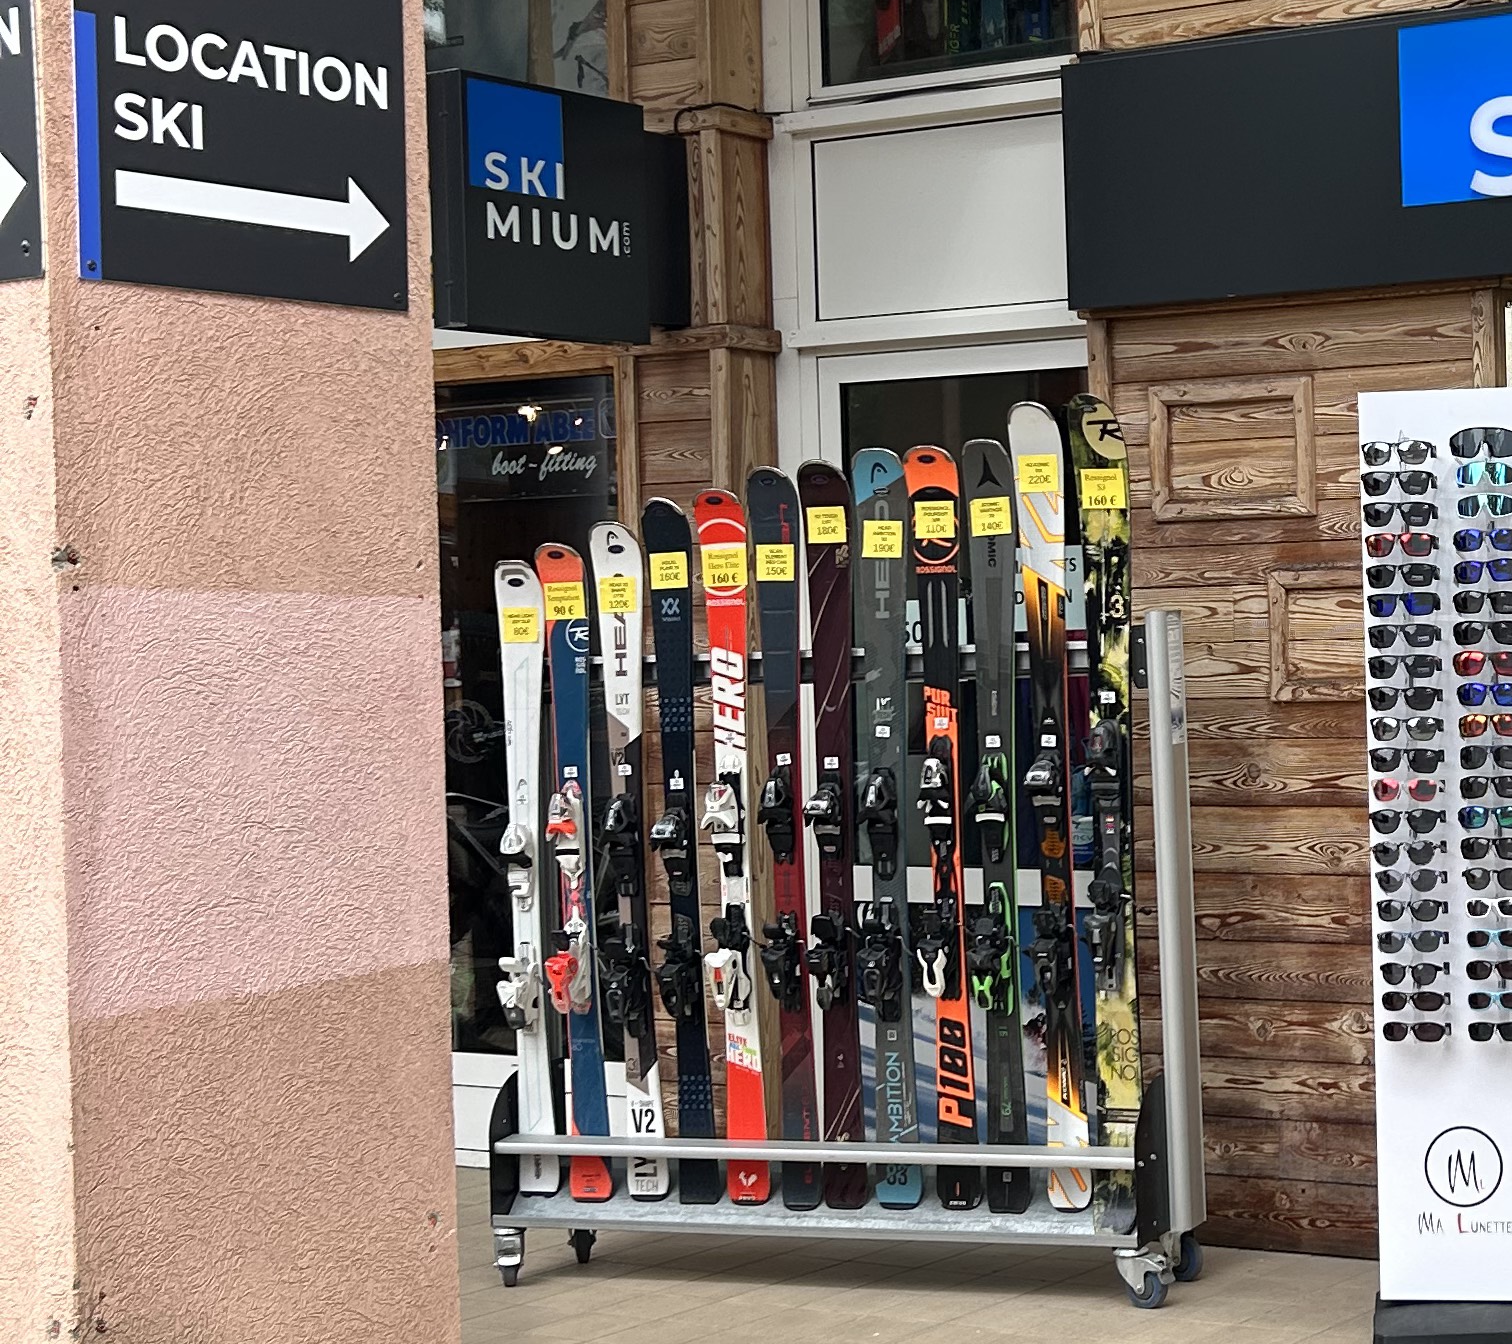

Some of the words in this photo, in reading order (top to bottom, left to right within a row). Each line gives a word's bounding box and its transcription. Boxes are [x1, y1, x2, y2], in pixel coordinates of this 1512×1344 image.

[114, 15, 390, 110] LOCATION
[114, 92, 204, 150] SKI
[485, 151, 565, 200] SKI
[486, 201, 620, 256] MIUM
[1088, 495, 1107, 506] 160
[1110, 494, 1118, 505] €
[711, 574, 730, 584] 160
[732, 573, 739, 583] €
[554, 606, 565, 616] 90
[568, 605, 575, 615] €
[631, 1108, 656, 1133] V2
[634, 1179, 658, 1192] TECH
